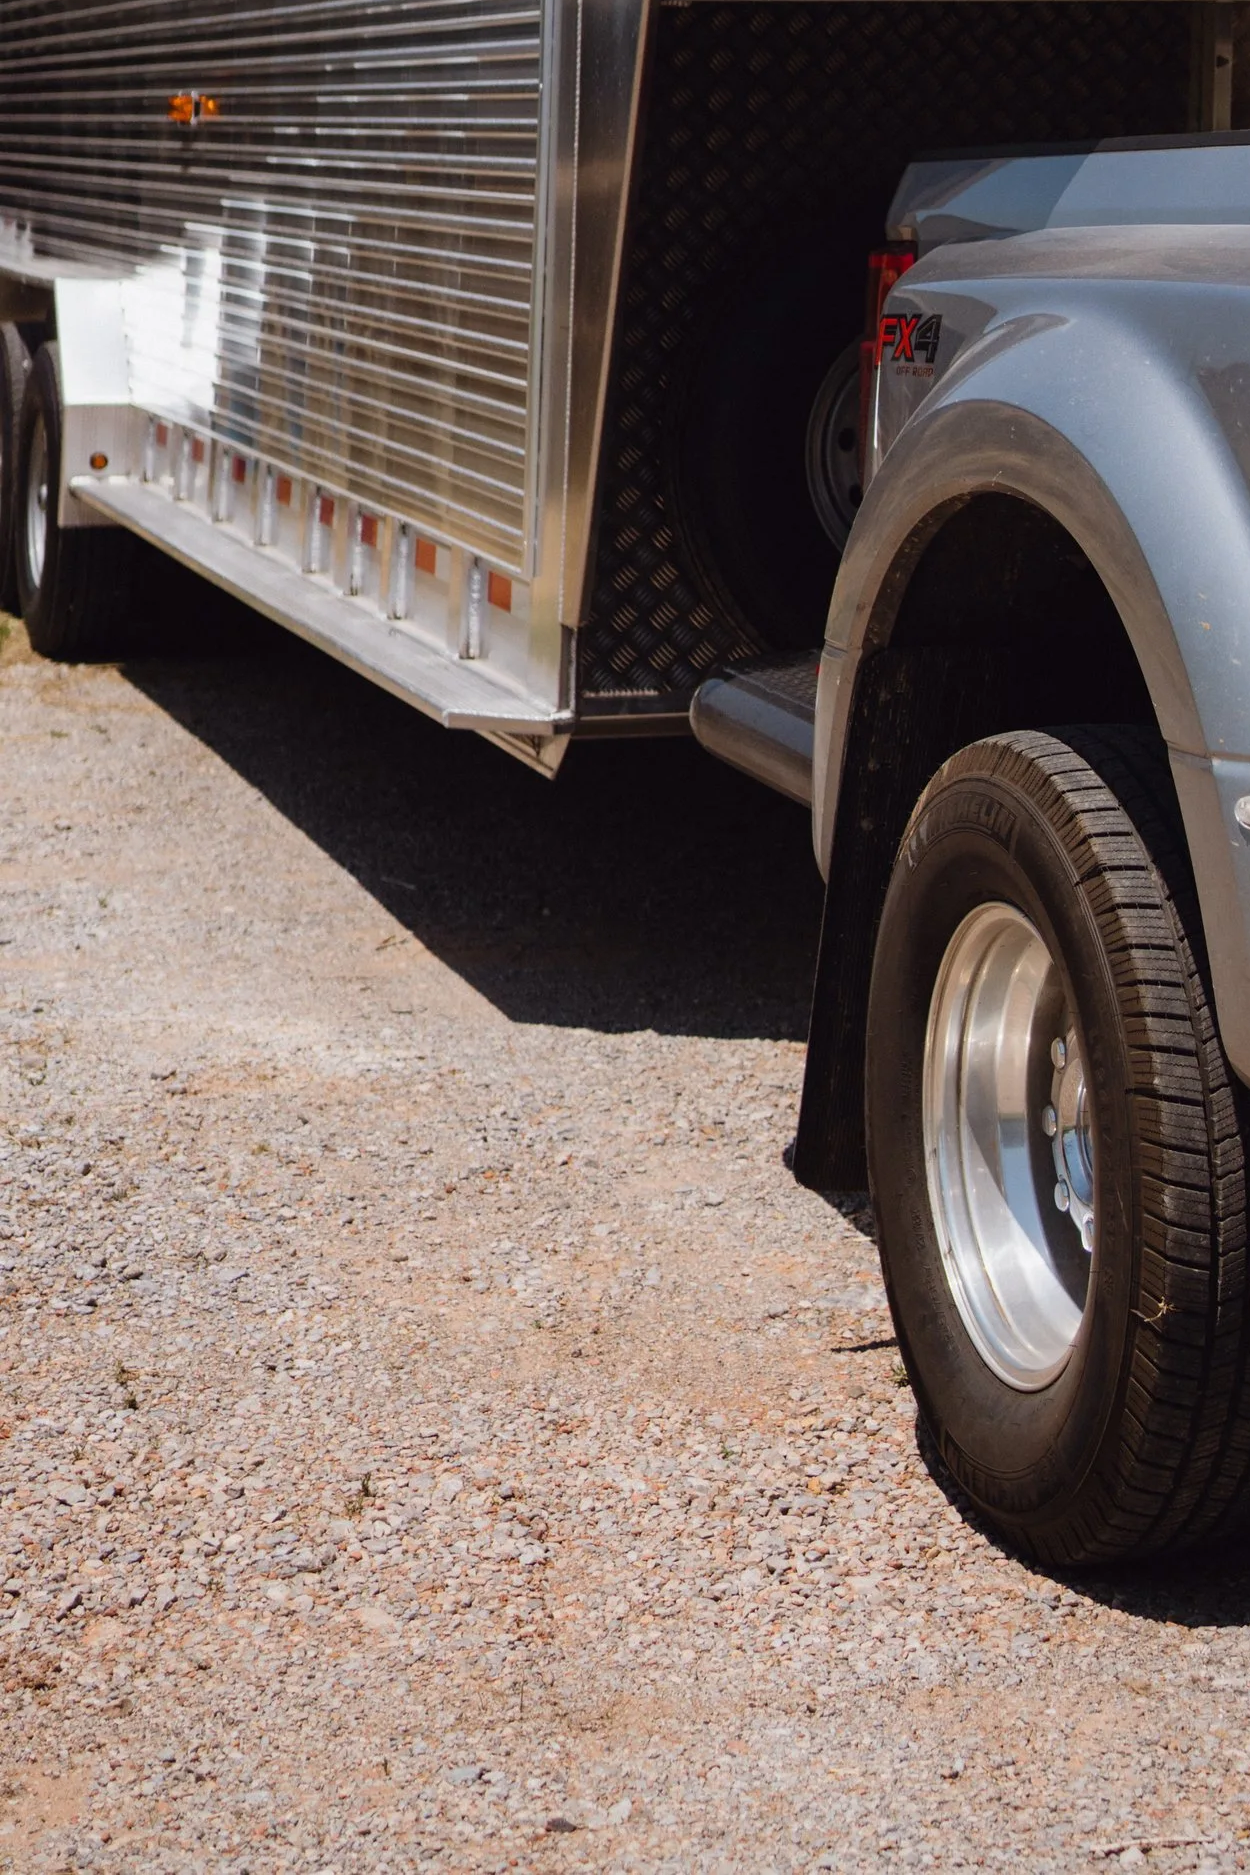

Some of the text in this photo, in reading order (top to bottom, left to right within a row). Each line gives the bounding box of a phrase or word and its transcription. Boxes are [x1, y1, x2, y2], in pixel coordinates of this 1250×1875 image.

[874, 313, 943, 370] FX4
[896, 366, 934, 377] OFF ROAD
